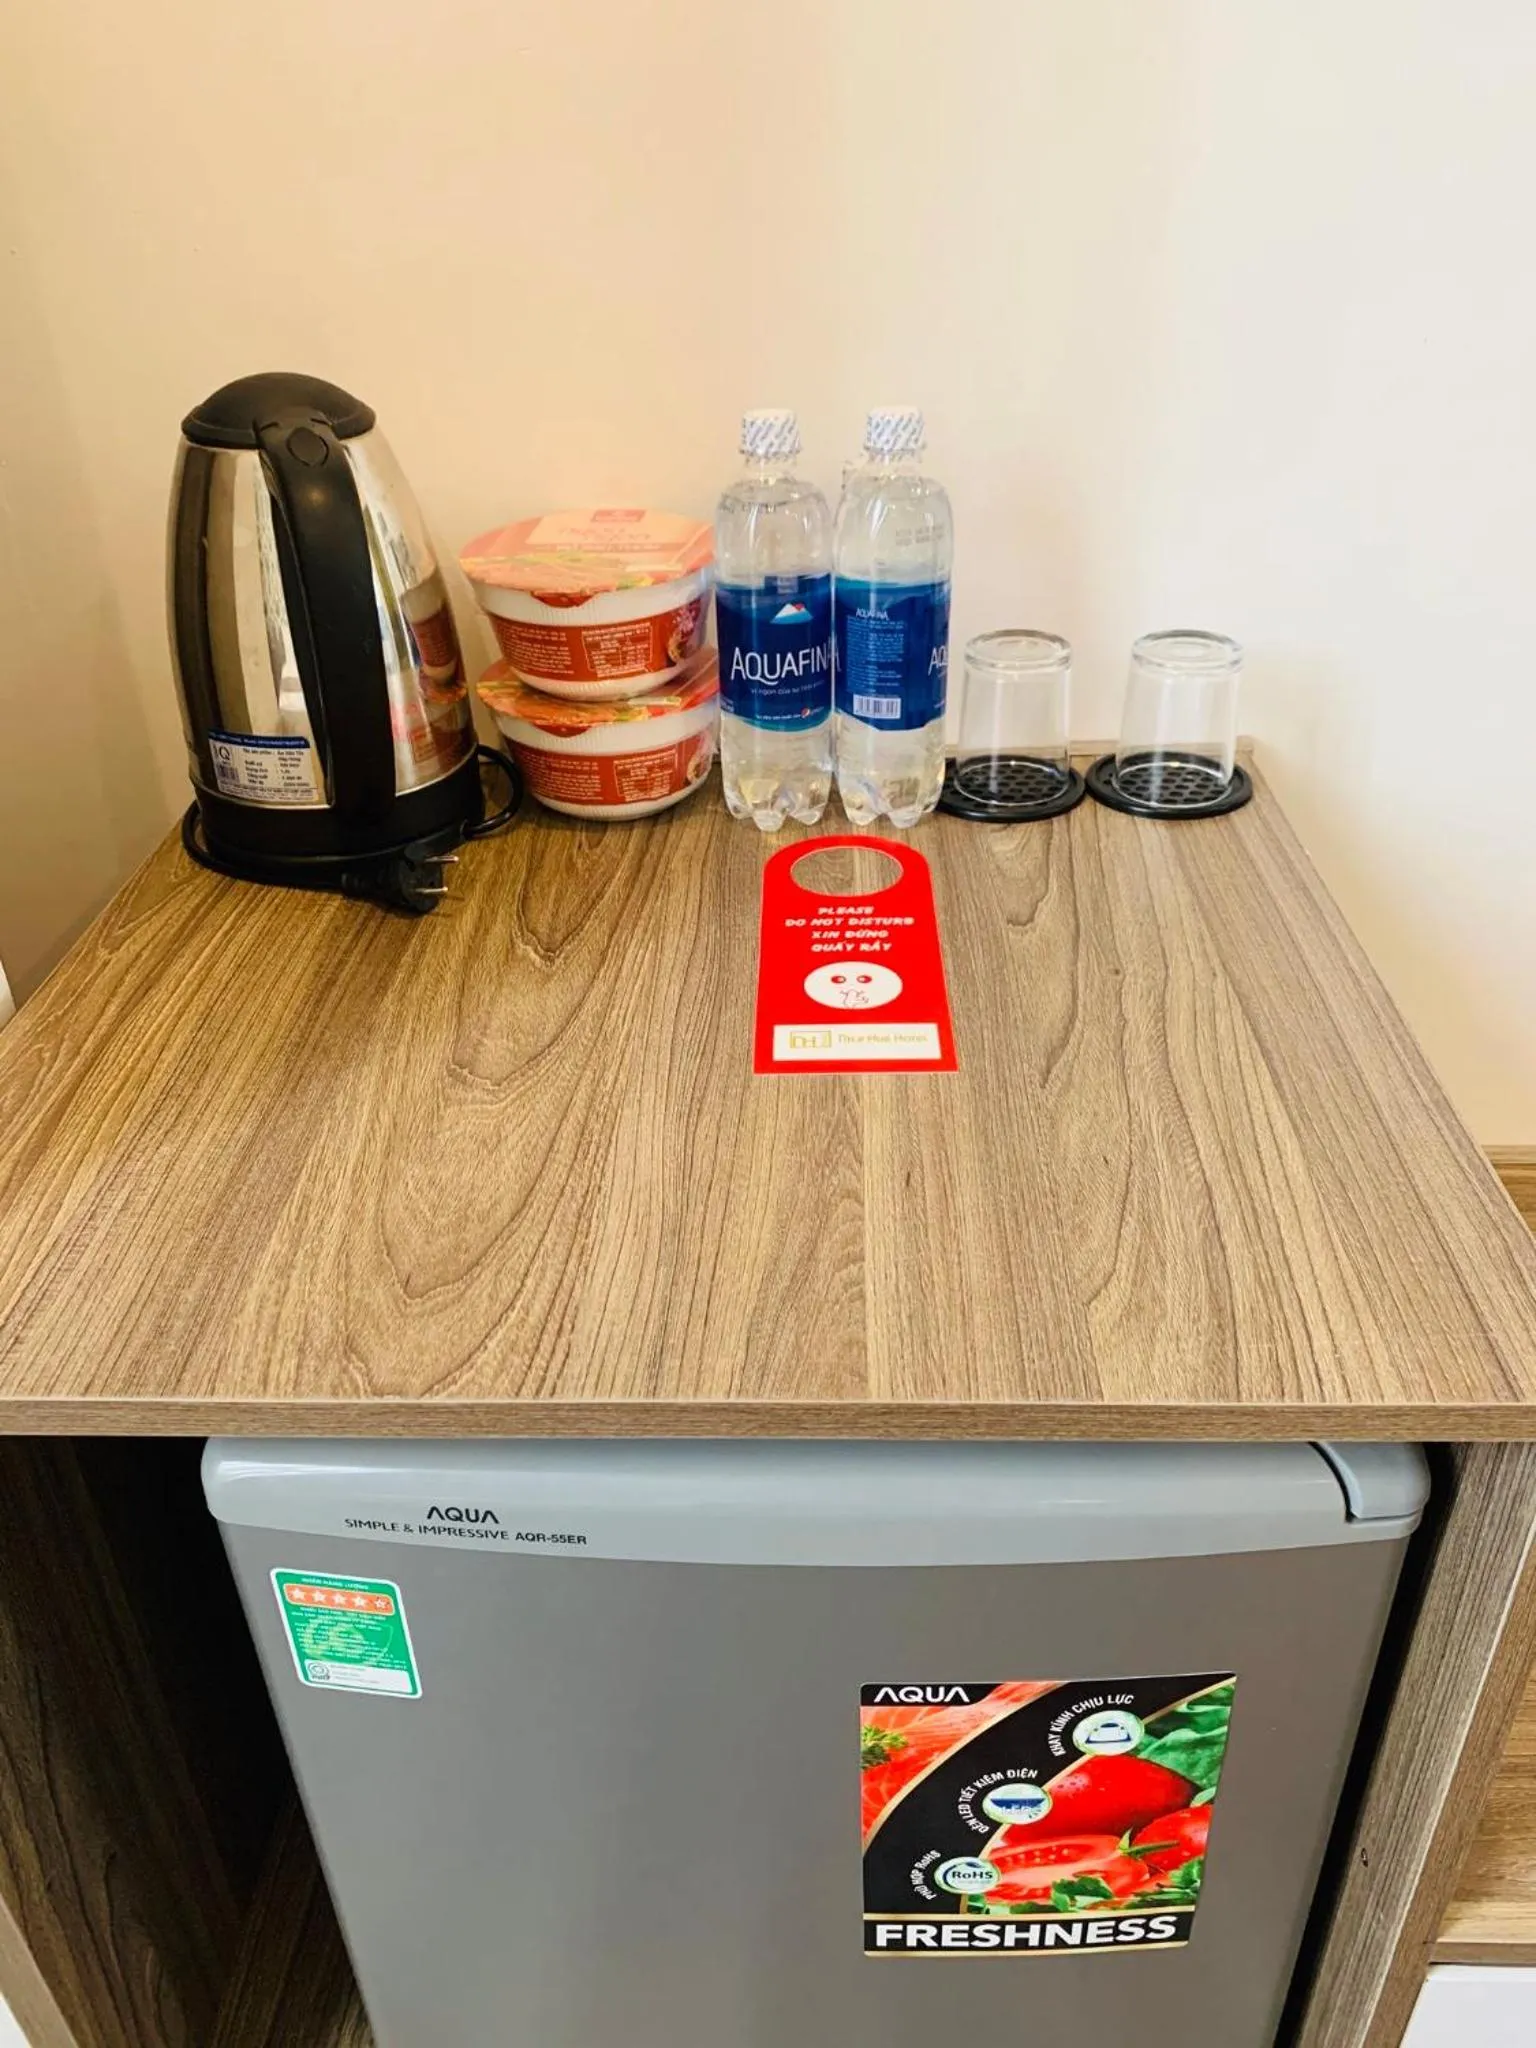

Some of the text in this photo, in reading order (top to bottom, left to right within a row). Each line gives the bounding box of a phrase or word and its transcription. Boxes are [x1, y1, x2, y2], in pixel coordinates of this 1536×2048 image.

[817, 905, 875, 916] PLEASE
[784, 916, 916, 928] DO NOT DISTURB
[810, 930, 841, 940] XIN
[427, 1506, 501, 1525] AQUA
[344, 1518, 588, 1545] SIMPLE & IMPRESSIVE AQR-55ER
[873, 1686, 971, 1704] AQUA
[1047, 1693, 1135, 1757] KHAY KÍNH CHỊU LỰC
[957, 1803, 974, 1820] LED
[951, 1871, 994, 1880] RoHS
[875, 1914, 1178, 1949] FRESHNESS
